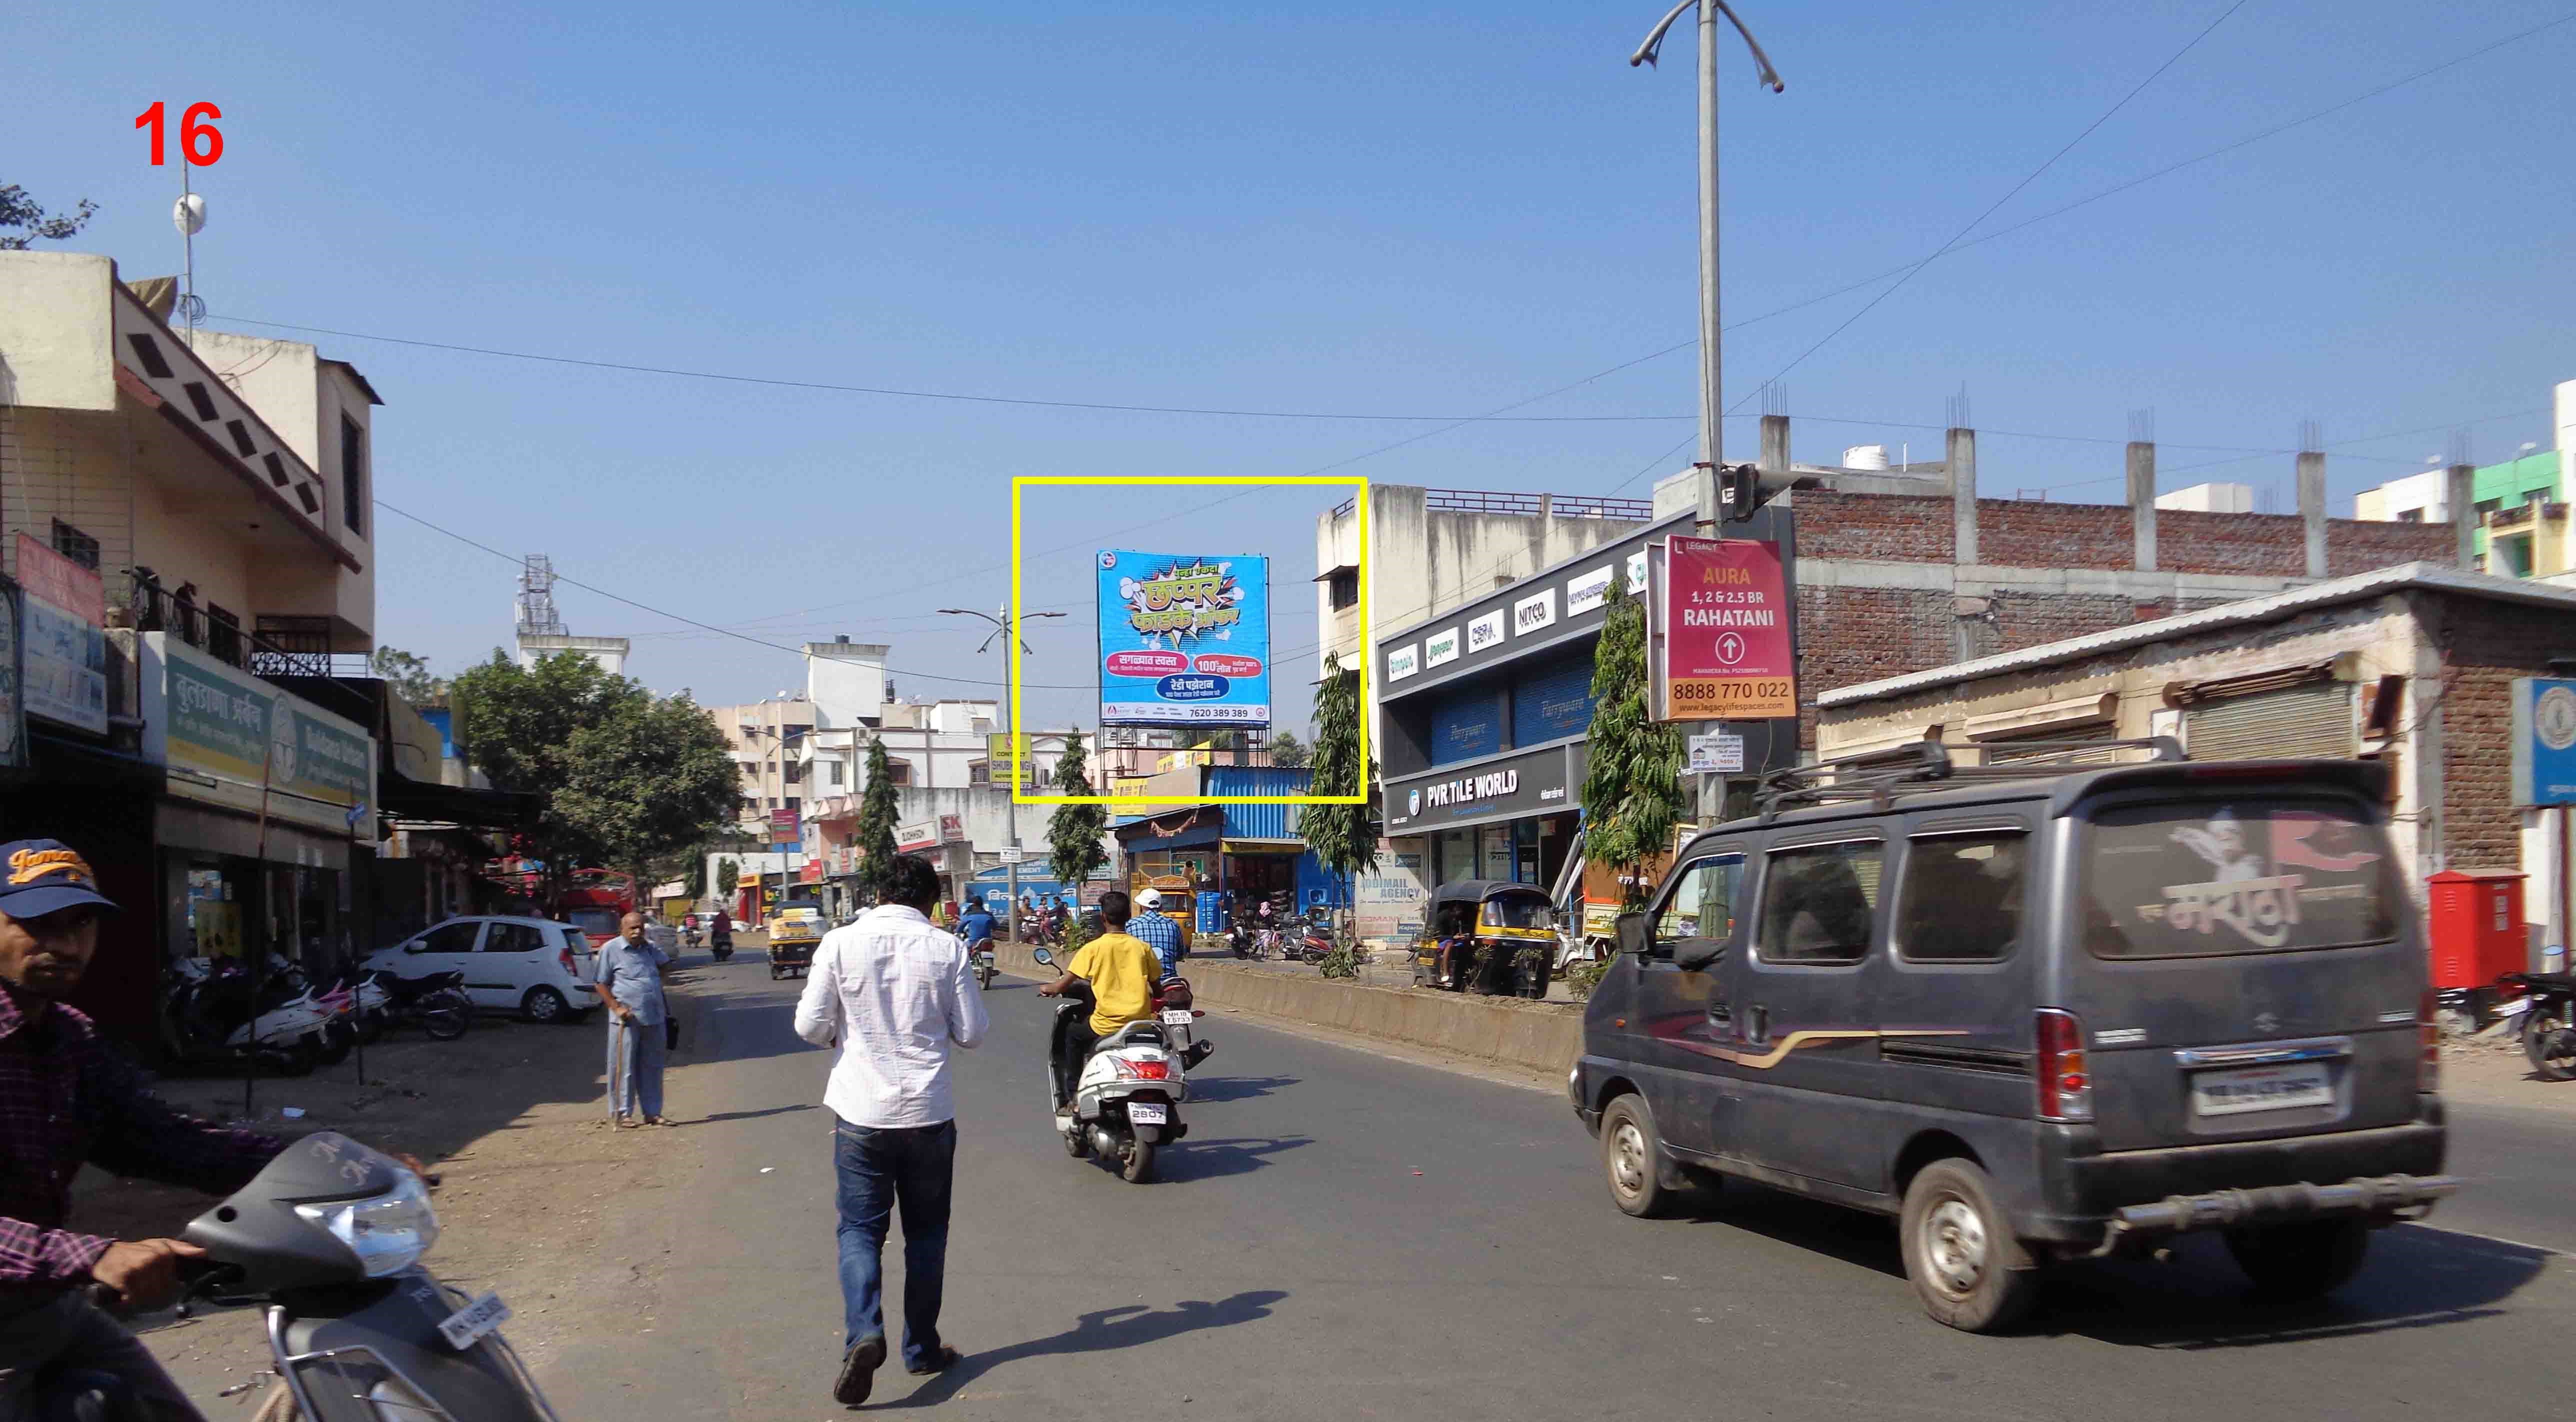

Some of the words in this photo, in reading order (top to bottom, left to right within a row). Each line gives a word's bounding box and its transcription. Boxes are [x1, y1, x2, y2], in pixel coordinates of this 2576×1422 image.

[1686, 541, 1717, 552] LEGACY
[1704, 568, 1752, 585] AURA
[1143, 576, 1222, 610] छप्पर
[1706, 592, 1712, 603] 2
[1716, 591, 1724, 603] &
[1726, 592, 1744, 603] 2.5
[1748, 592, 1764, 603] BR
[1519, 602, 1544, 625] NITCO
[1684, 609, 1774, 626] RAHATANI
[1674, 684, 1716, 699] 8888
[1721, 683, 1752, 698] 770
[1758, 682, 1788, 698] 022
[1190, 709, 1211, 718] 7620
[1213, 709, 1230, 717] 389
[1232, 709, 1248, 718] 389
[1428, 784, 1448, 807] PVR
[1475, 769, 1518, 797] WORLD
[944, 816, 961, 829] SK
[1380, 888, 1420, 898] AGENCY
[2161, 873, 2306, 948] मराठा
